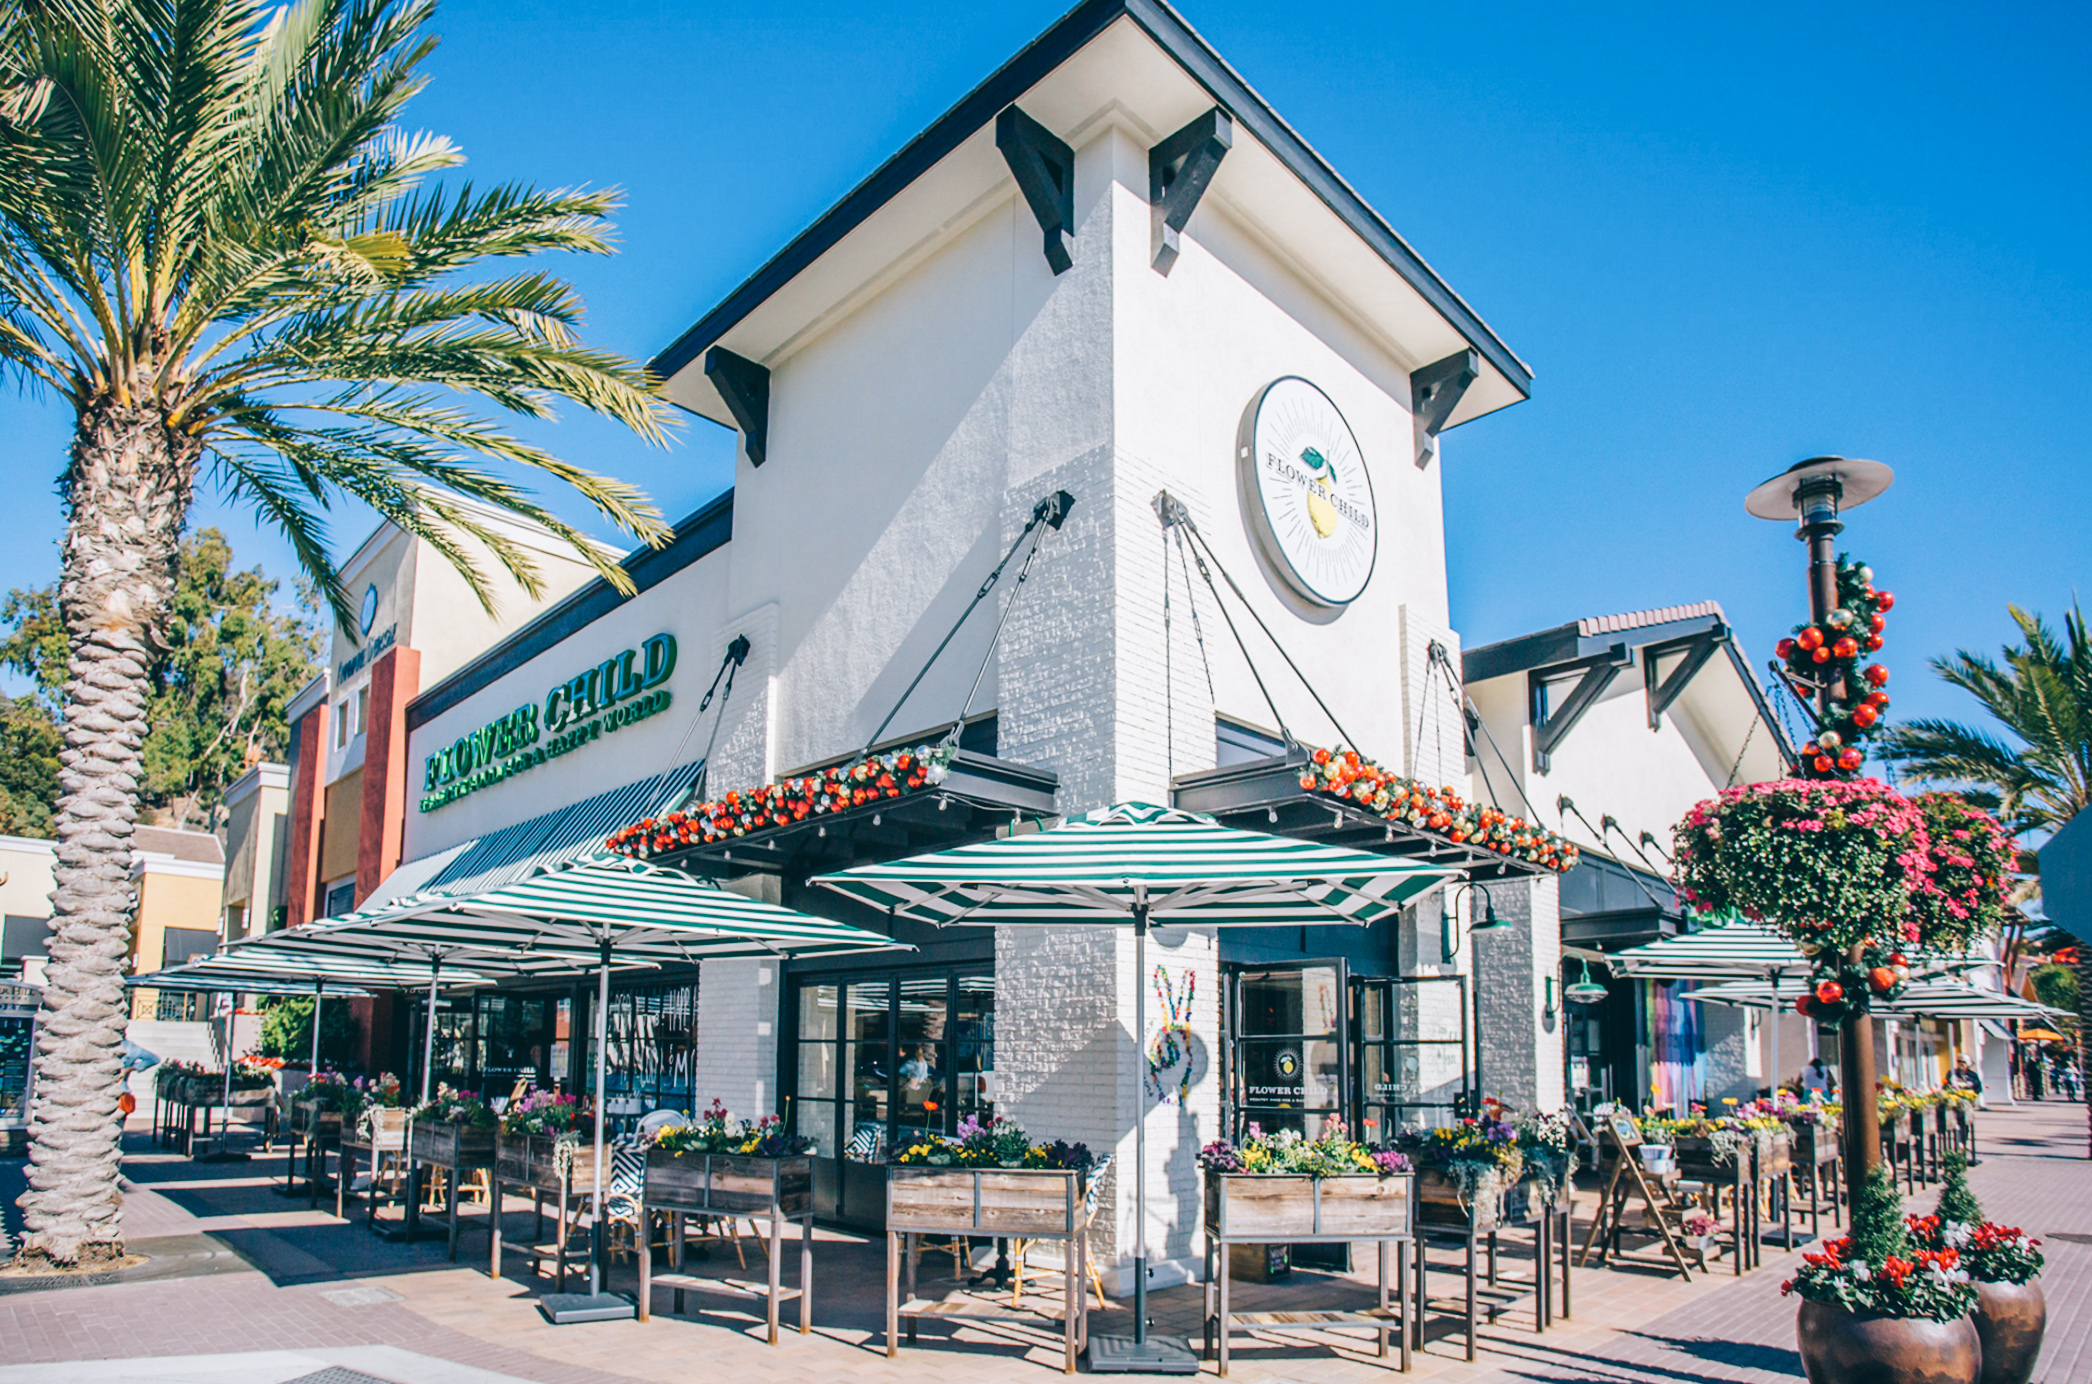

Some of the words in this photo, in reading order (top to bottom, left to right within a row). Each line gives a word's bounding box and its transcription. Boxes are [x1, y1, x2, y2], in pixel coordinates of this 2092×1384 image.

[1266, 452, 1327, 501] FLOWER
[1330, 493, 1369, 530] CHILD
[423, 703, 540, 791] FLOWER
[544, 632, 677, 733] CHILD
[546, 718, 600, 758] HAPPY
[602, 690, 671, 733] WORLD
[1248, 1086, 1292, 1095] FLOWER
[1293, 1086, 1328, 1096] CHILD
